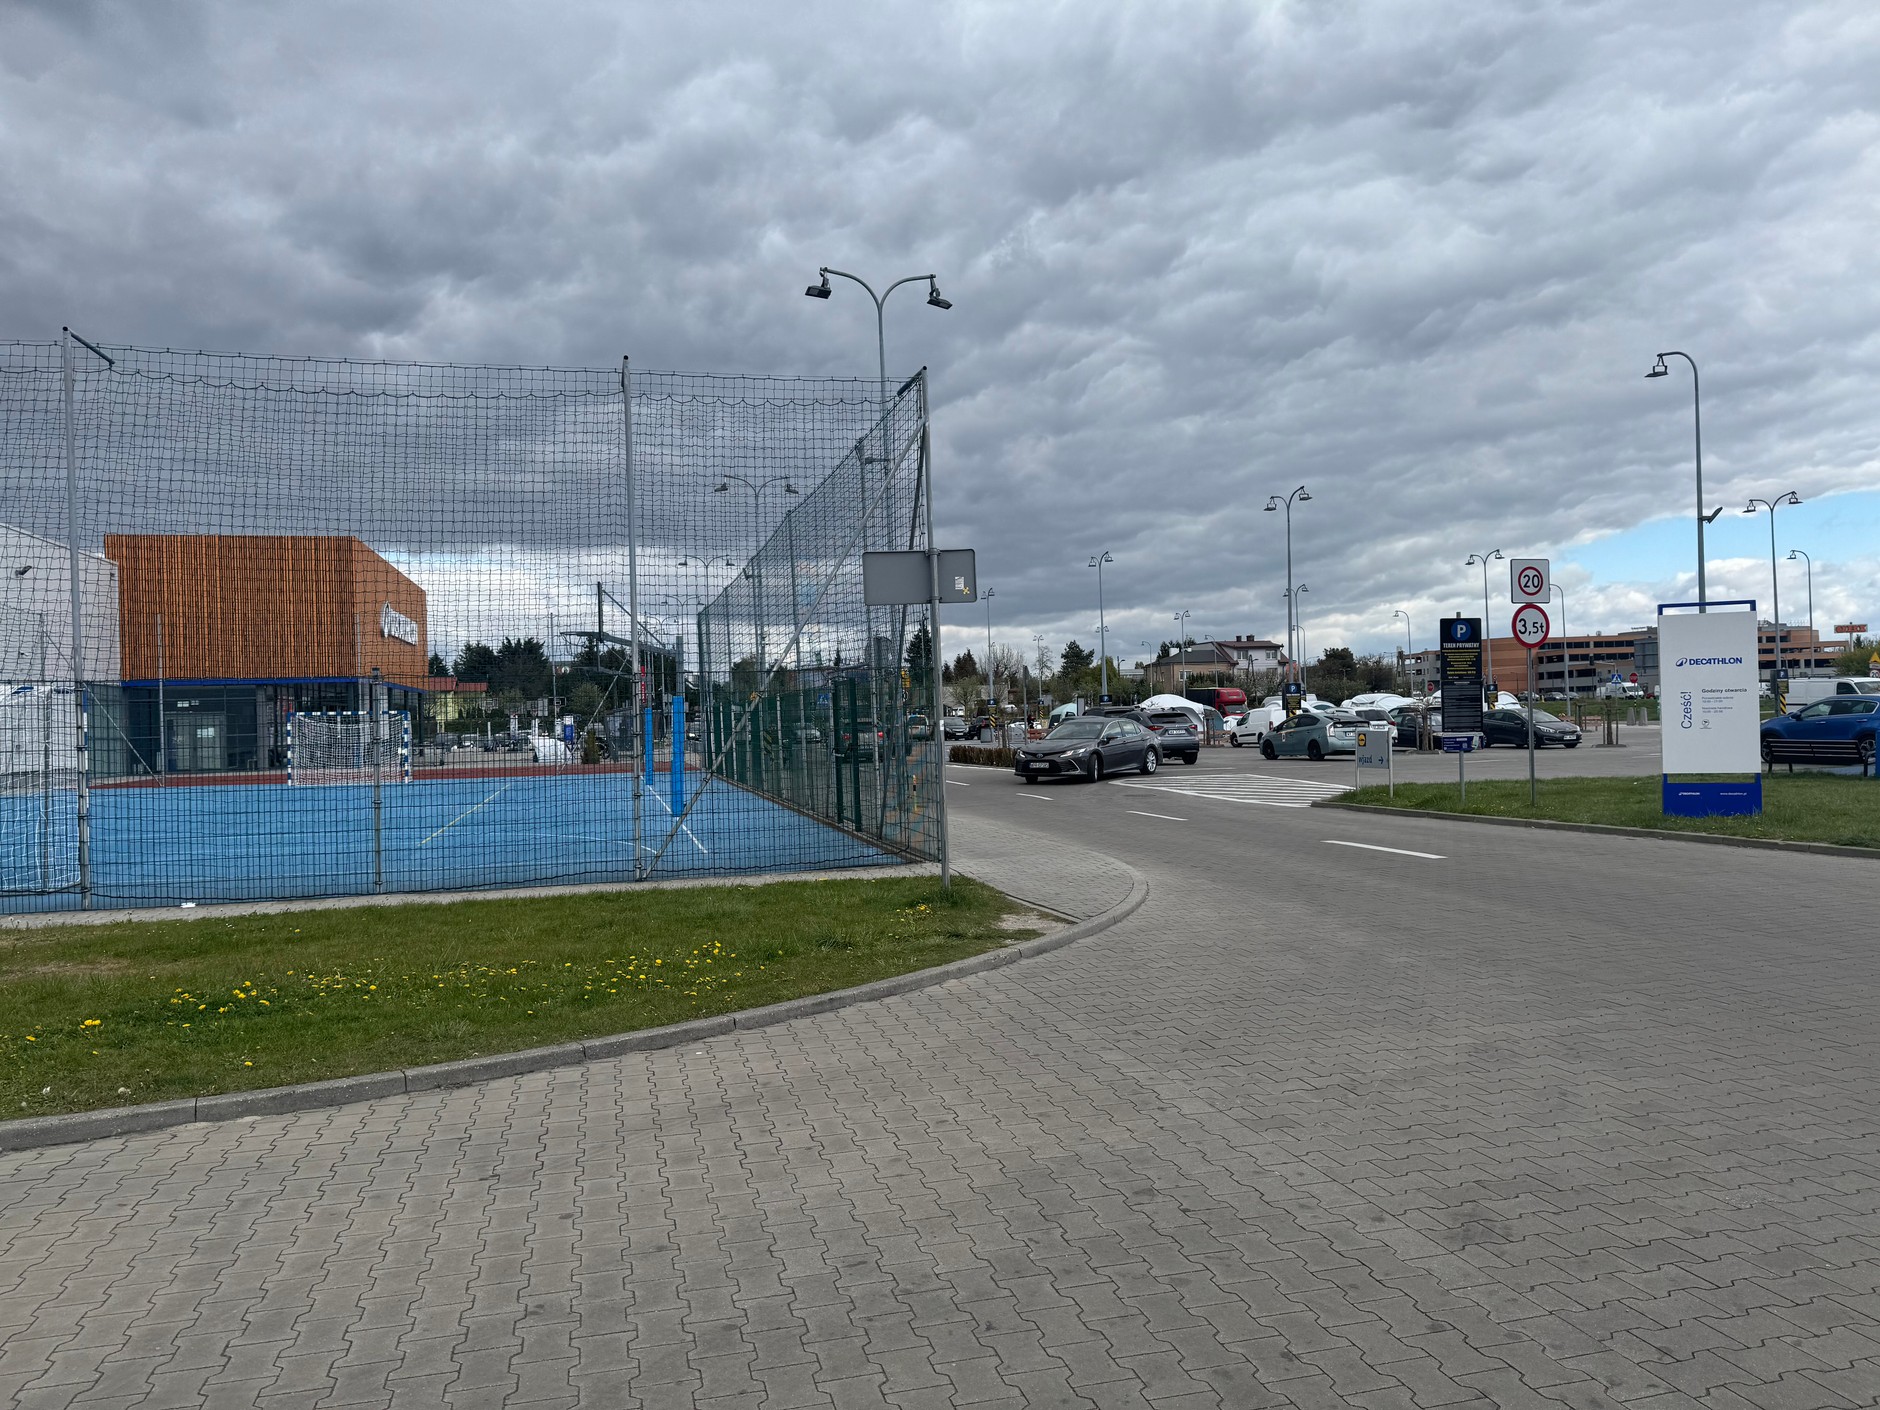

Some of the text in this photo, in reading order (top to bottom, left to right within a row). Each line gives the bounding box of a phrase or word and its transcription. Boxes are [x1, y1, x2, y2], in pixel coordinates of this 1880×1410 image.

[1523, 574, 1539, 588] 20
[1457, 624, 1466, 638] P
[1518, 618, 1544, 636] 3,5t
[1689, 657, 1743, 666] DECATHLON
[1680, 691, 1692, 729] Cześć!
